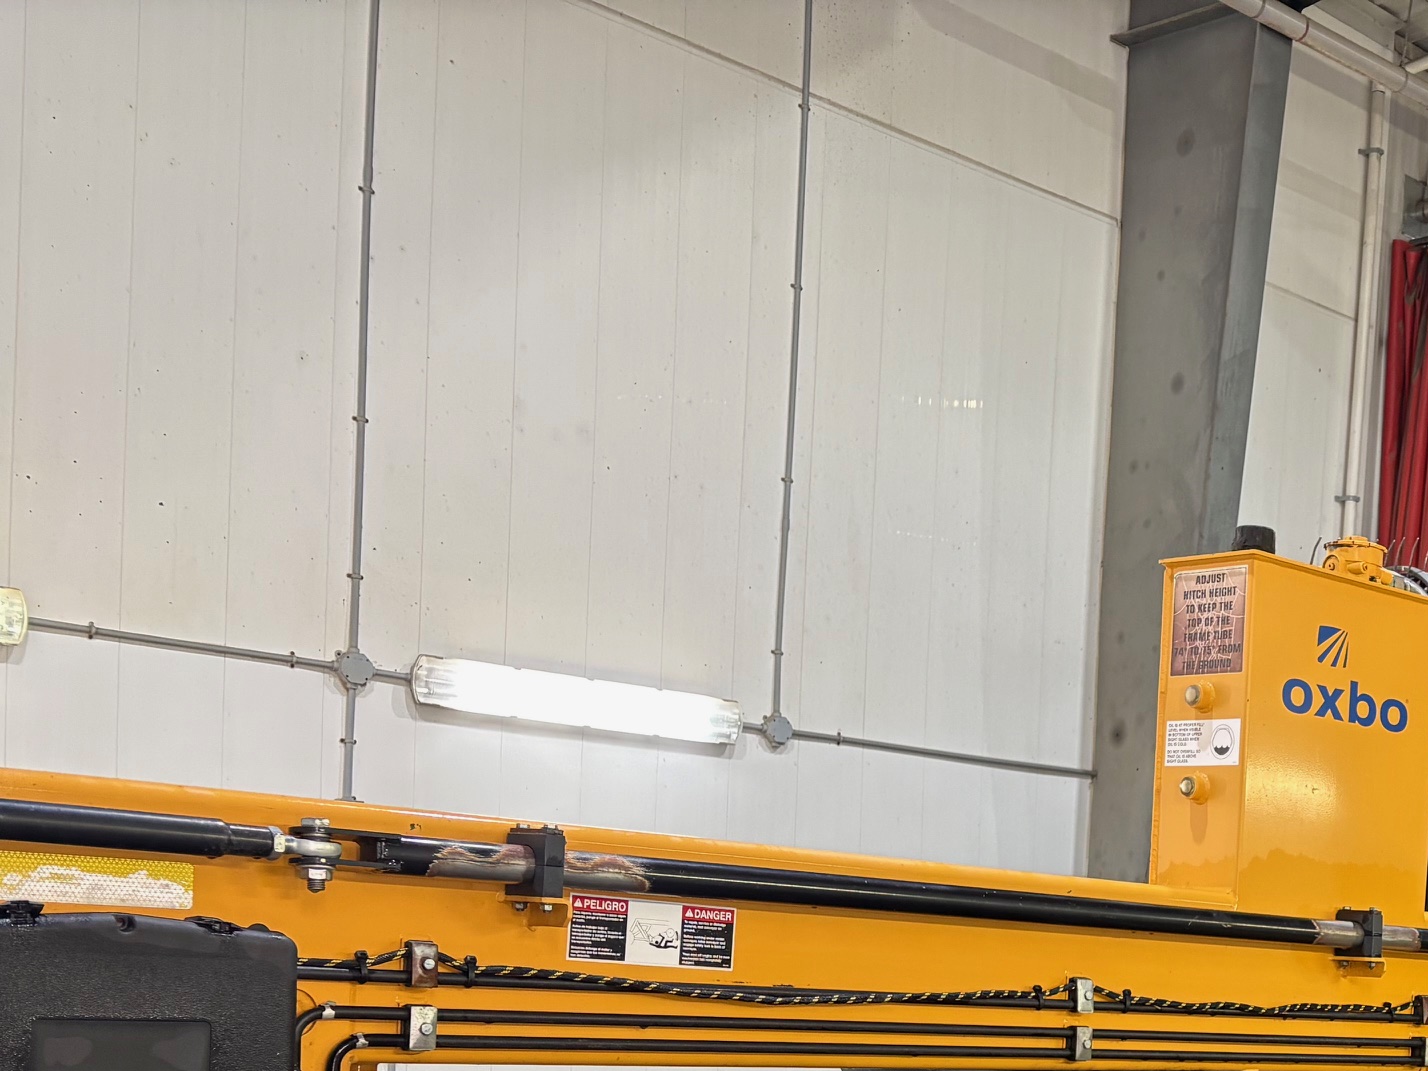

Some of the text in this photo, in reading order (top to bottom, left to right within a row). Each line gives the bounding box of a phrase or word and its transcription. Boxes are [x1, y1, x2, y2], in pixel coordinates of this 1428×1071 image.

[1196, 573, 1226, 585] ADJUST
[1184, 586, 1237, 600] HITCH HEIGHT
[1186, 601, 1233, 614] TO KEEP THE
[1187, 618, 1202, 628] TOP
[1217, 615, 1230, 626] THE
[1214, 629, 1233, 640] TUBE
[1282, 678, 1408, 733] oxbo
[584, 899, 626, 911] PELIGRO
[695, 910, 731, 921] DANGER
